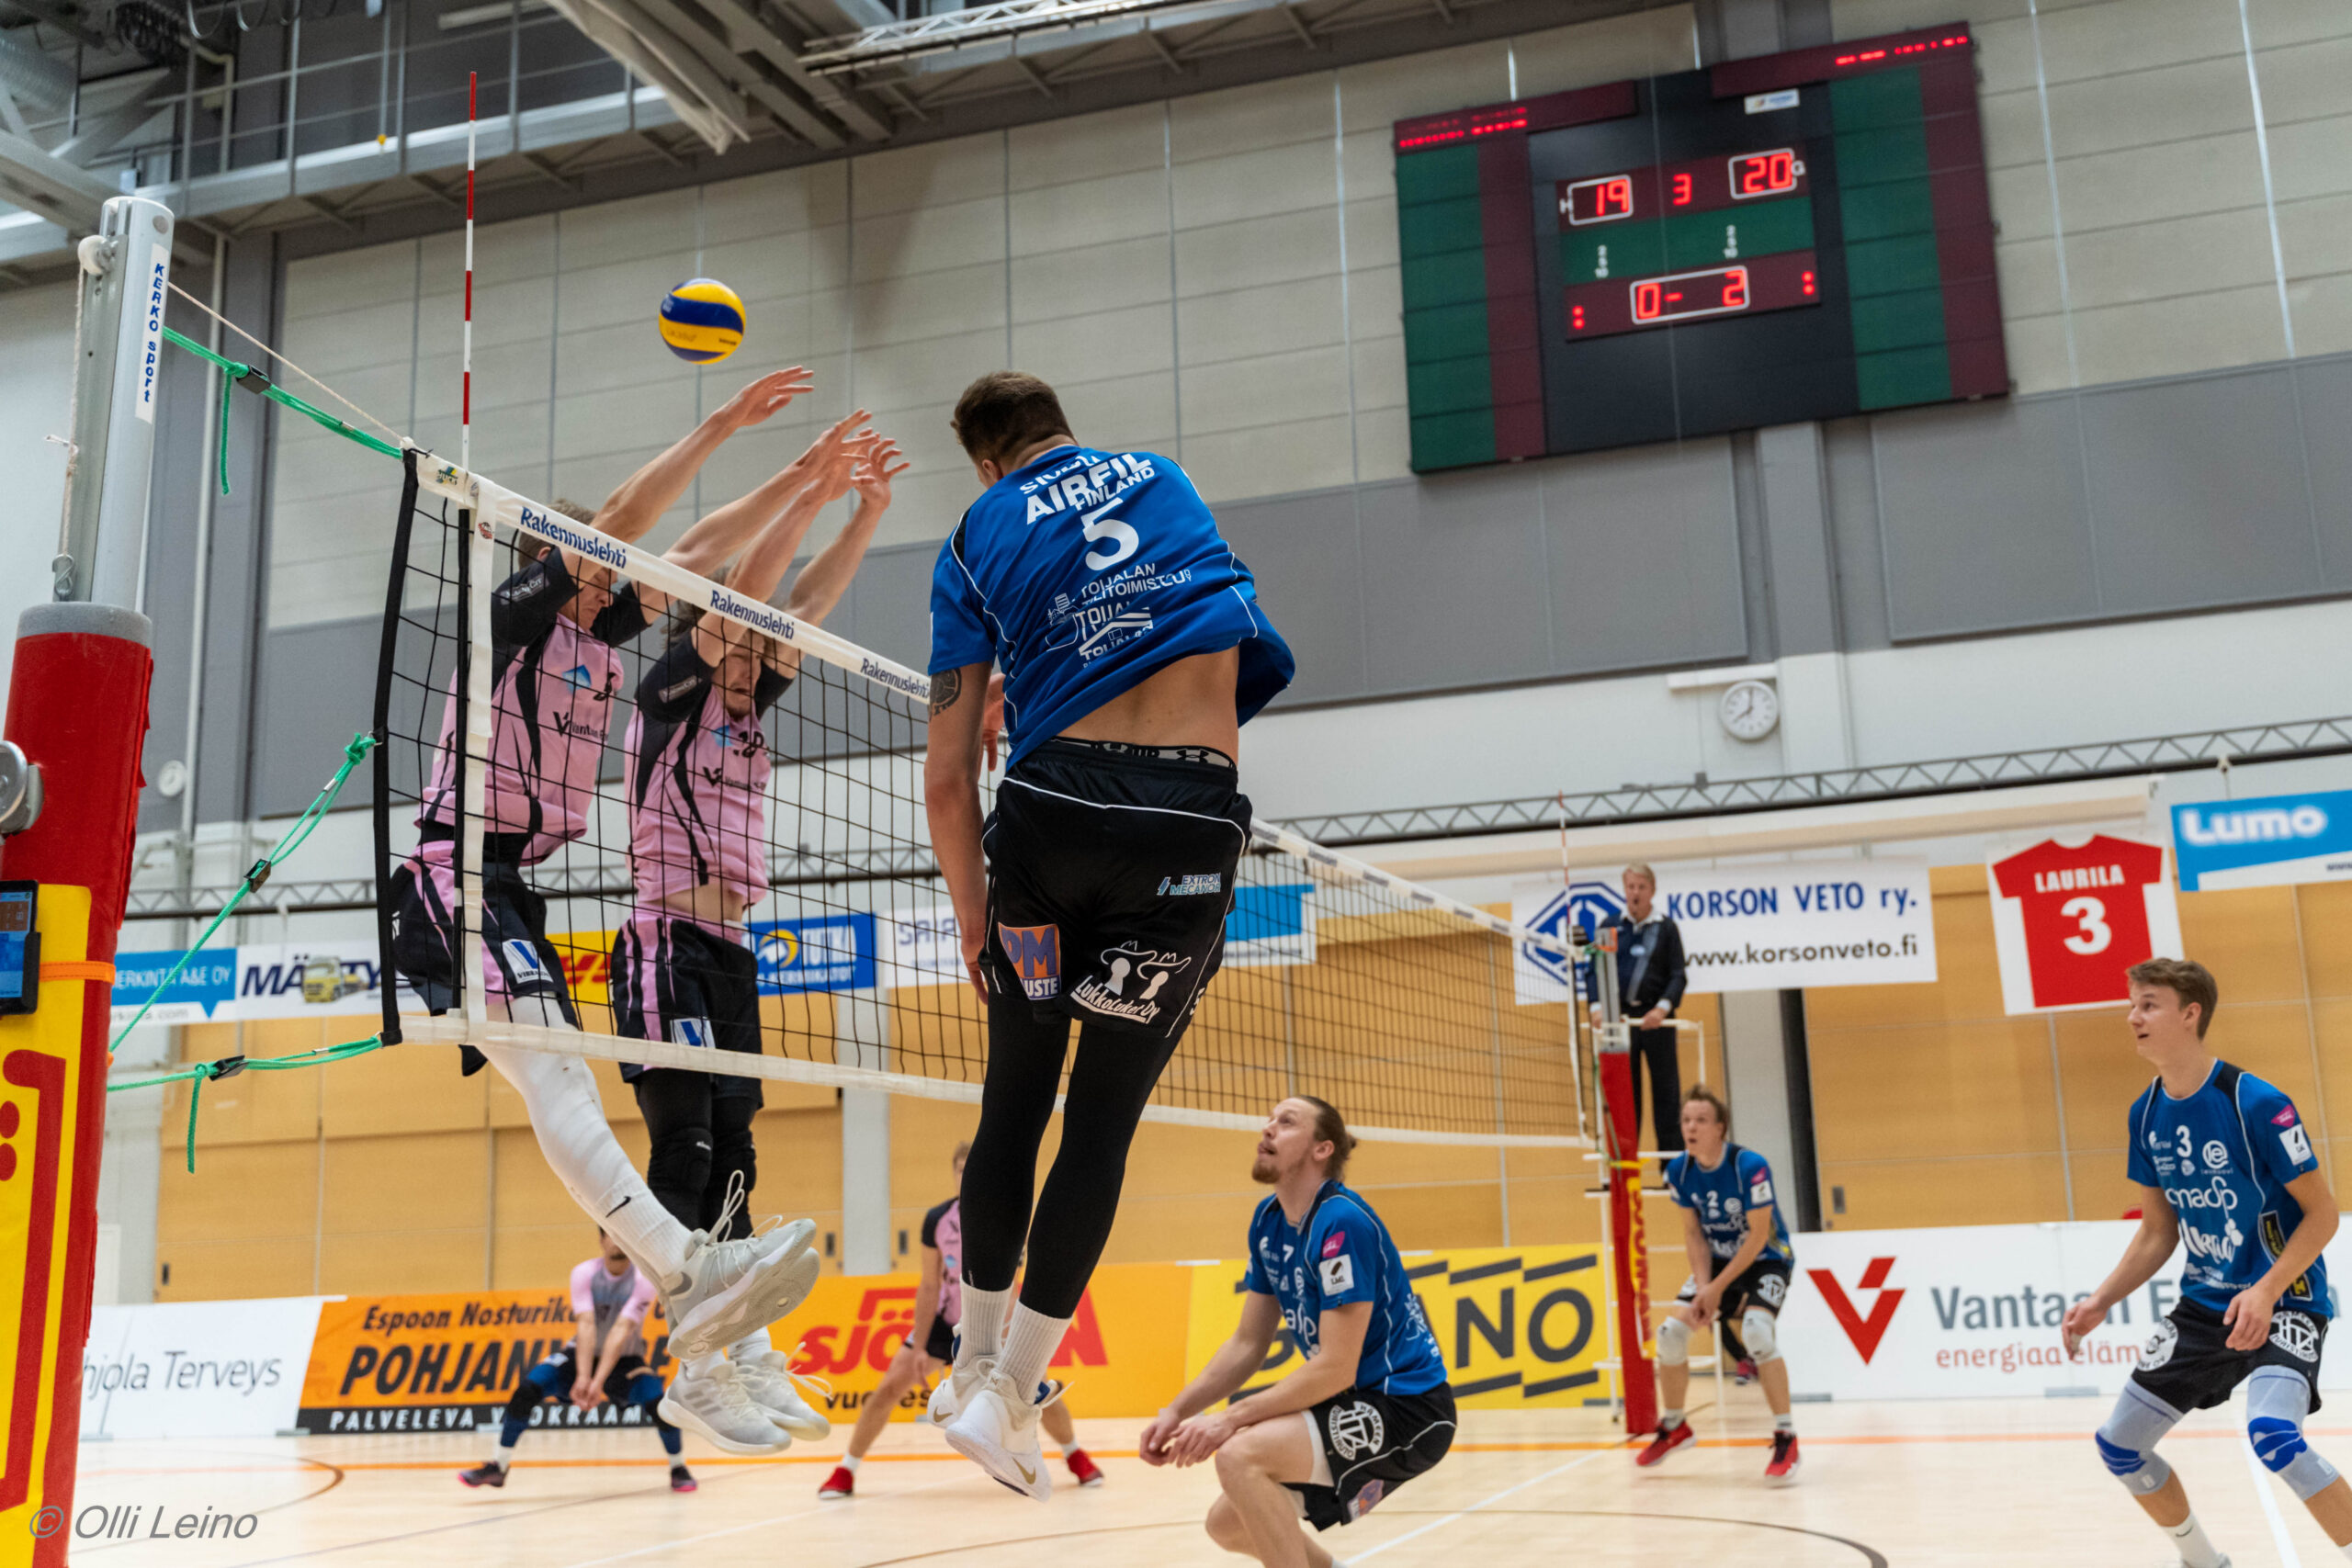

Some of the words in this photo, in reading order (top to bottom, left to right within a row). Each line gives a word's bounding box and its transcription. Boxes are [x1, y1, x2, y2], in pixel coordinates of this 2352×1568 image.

[1597, 179, 1630, 217] 19
[1673, 174, 1691, 205] 3
[1744, 152, 1792, 194] 20
[148, 263, 165, 333] KERKO
[142, 341, 157, 403] sport
[1027, 453, 1151, 525] AIRFIL
[1075, 467, 1155, 511] FINLAND
[520, 506, 627, 569] Rakennuslehti
[1080, 497, 1139, 570] 5
[710, 590, 795, 640] Rakennuslehti
[860, 658, 930, 699] Rakennuslehti
[2180, 806, 2329, 845] Lumo
[1182, 873, 1222, 885] EXTRON
[2034, 863, 2125, 893] LAURILA
[1667, 886, 1778, 920] KORSON
[1794, 882, 1864, 912] VETO
[1881, 887, 1917, 917] ry.
[899, 919, 957, 946] SAIP
[2060, 897, 2112, 955] 3
[2176, 1124, 2192, 1157] 3
[1706, 1190, 1719, 1208] 2
[1283, 1244, 1294, 1262] 7
[362, 1304, 452, 1337] Espoon
[165, 1349, 282, 1396] Terveys
[1936, 1342, 2063, 1374] energiaa
[2073, 1339, 2142, 1365] eläm
[330, 1407, 475, 1432] PALVELEVA
[491, 1403, 654, 1427] VOKRAAM
